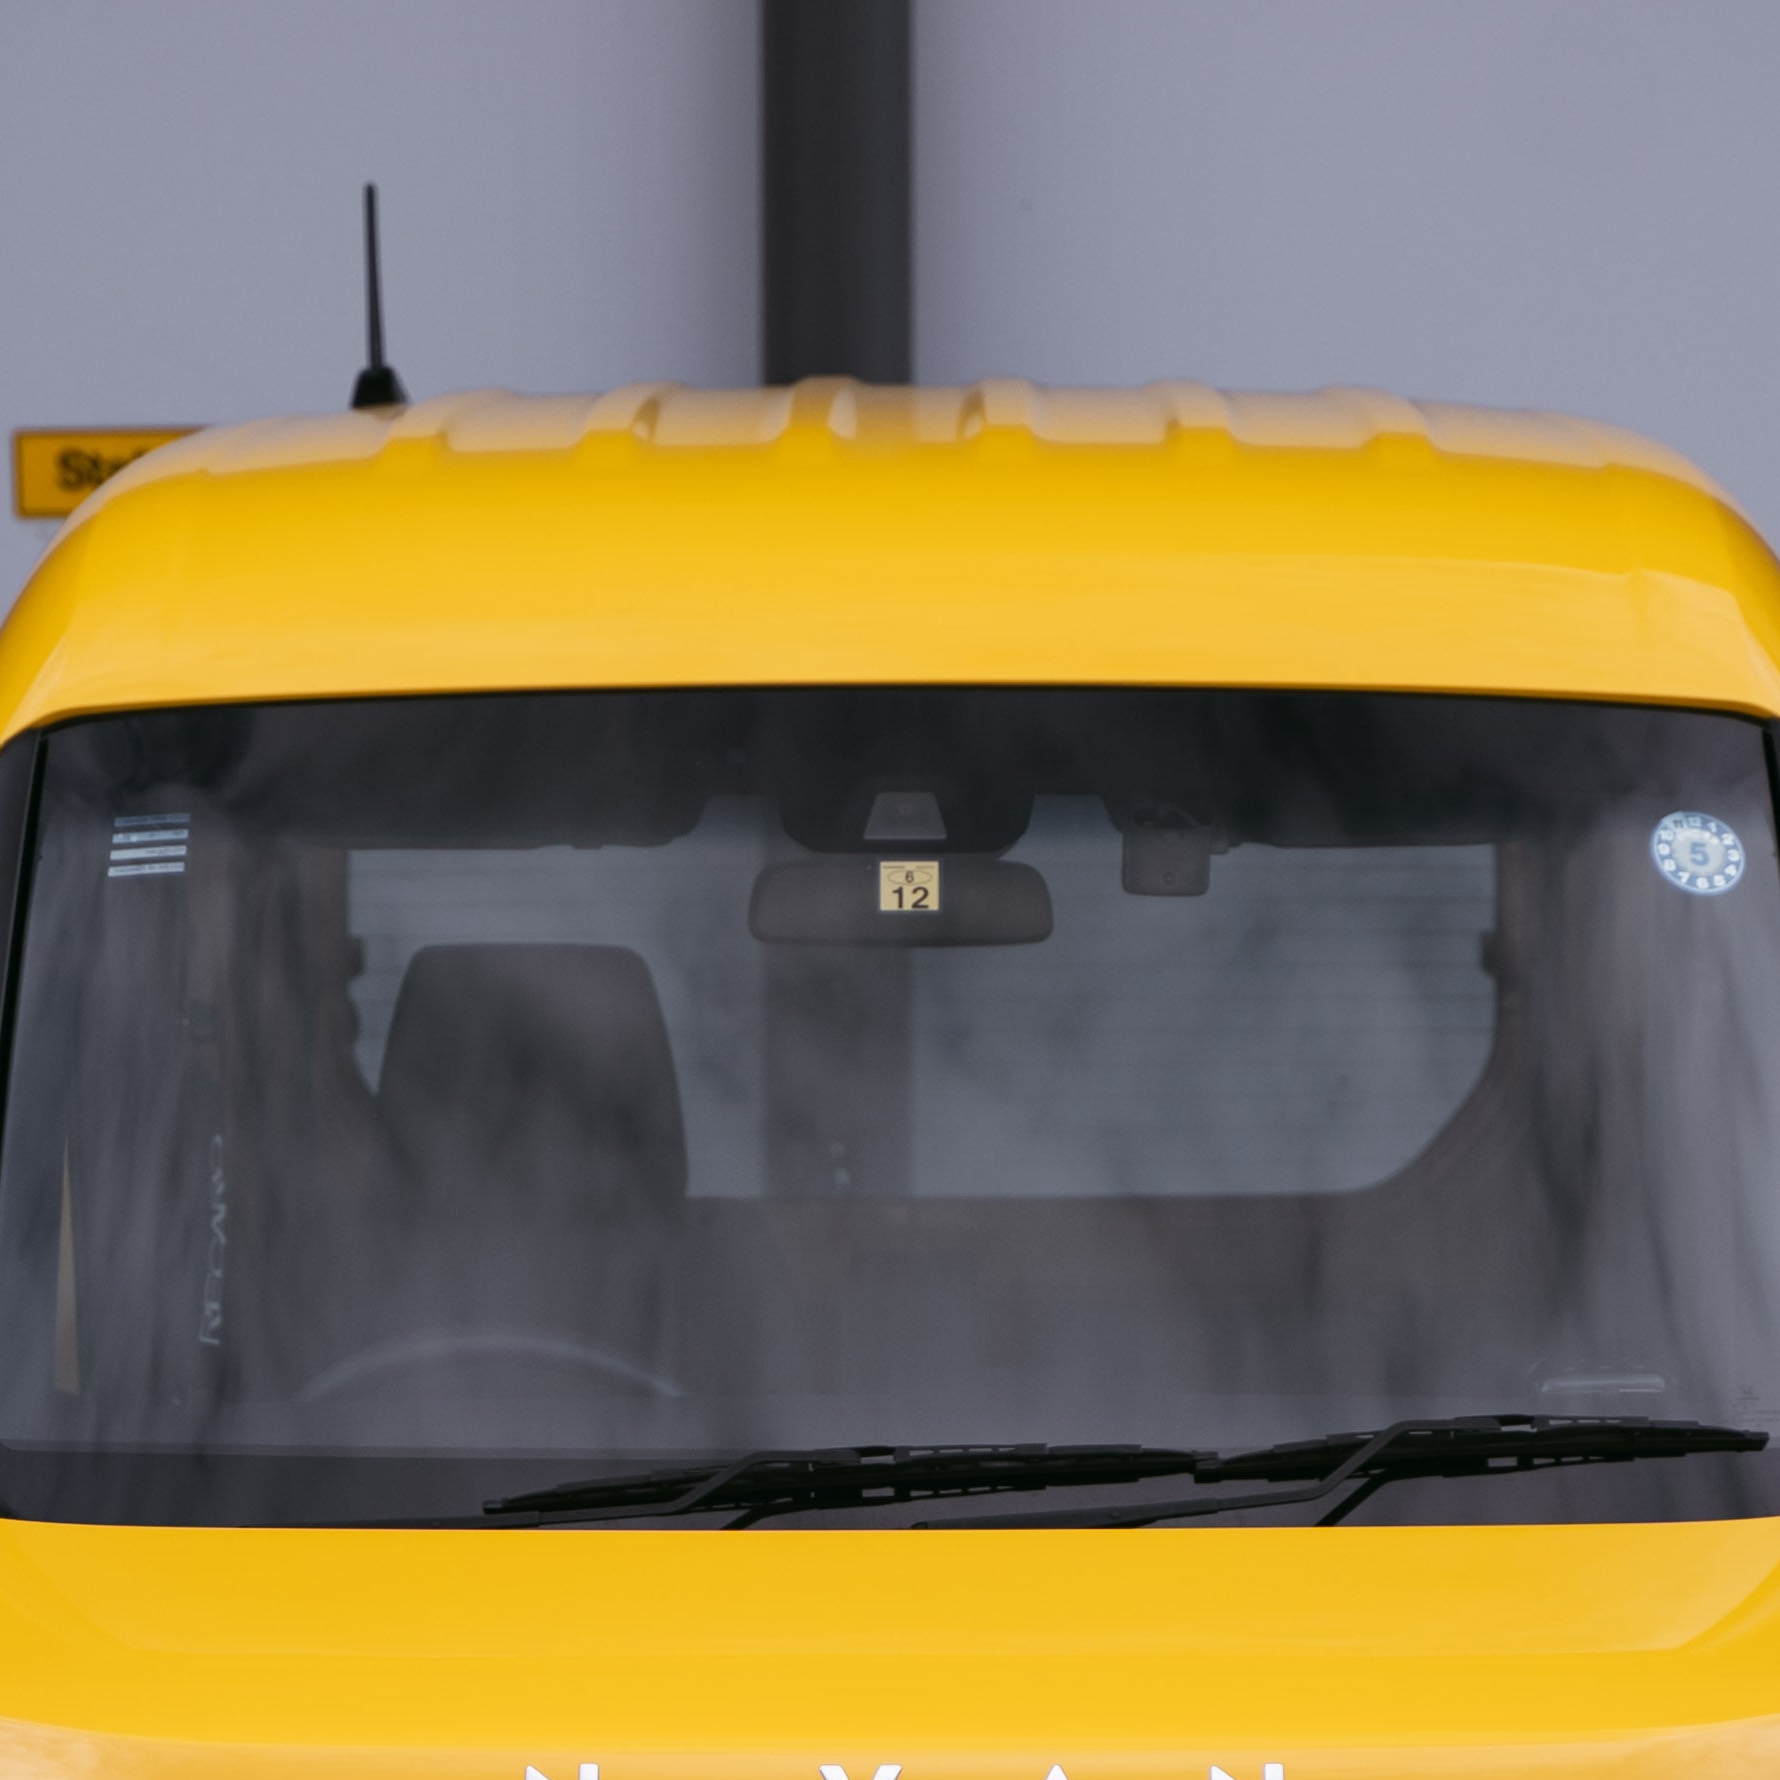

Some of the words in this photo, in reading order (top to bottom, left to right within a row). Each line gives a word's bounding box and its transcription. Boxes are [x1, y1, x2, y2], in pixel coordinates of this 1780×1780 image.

[1689, 841, 1710, 866] 5
[905, 870, 914, 884] 6
[892, 886, 929, 909] 12
